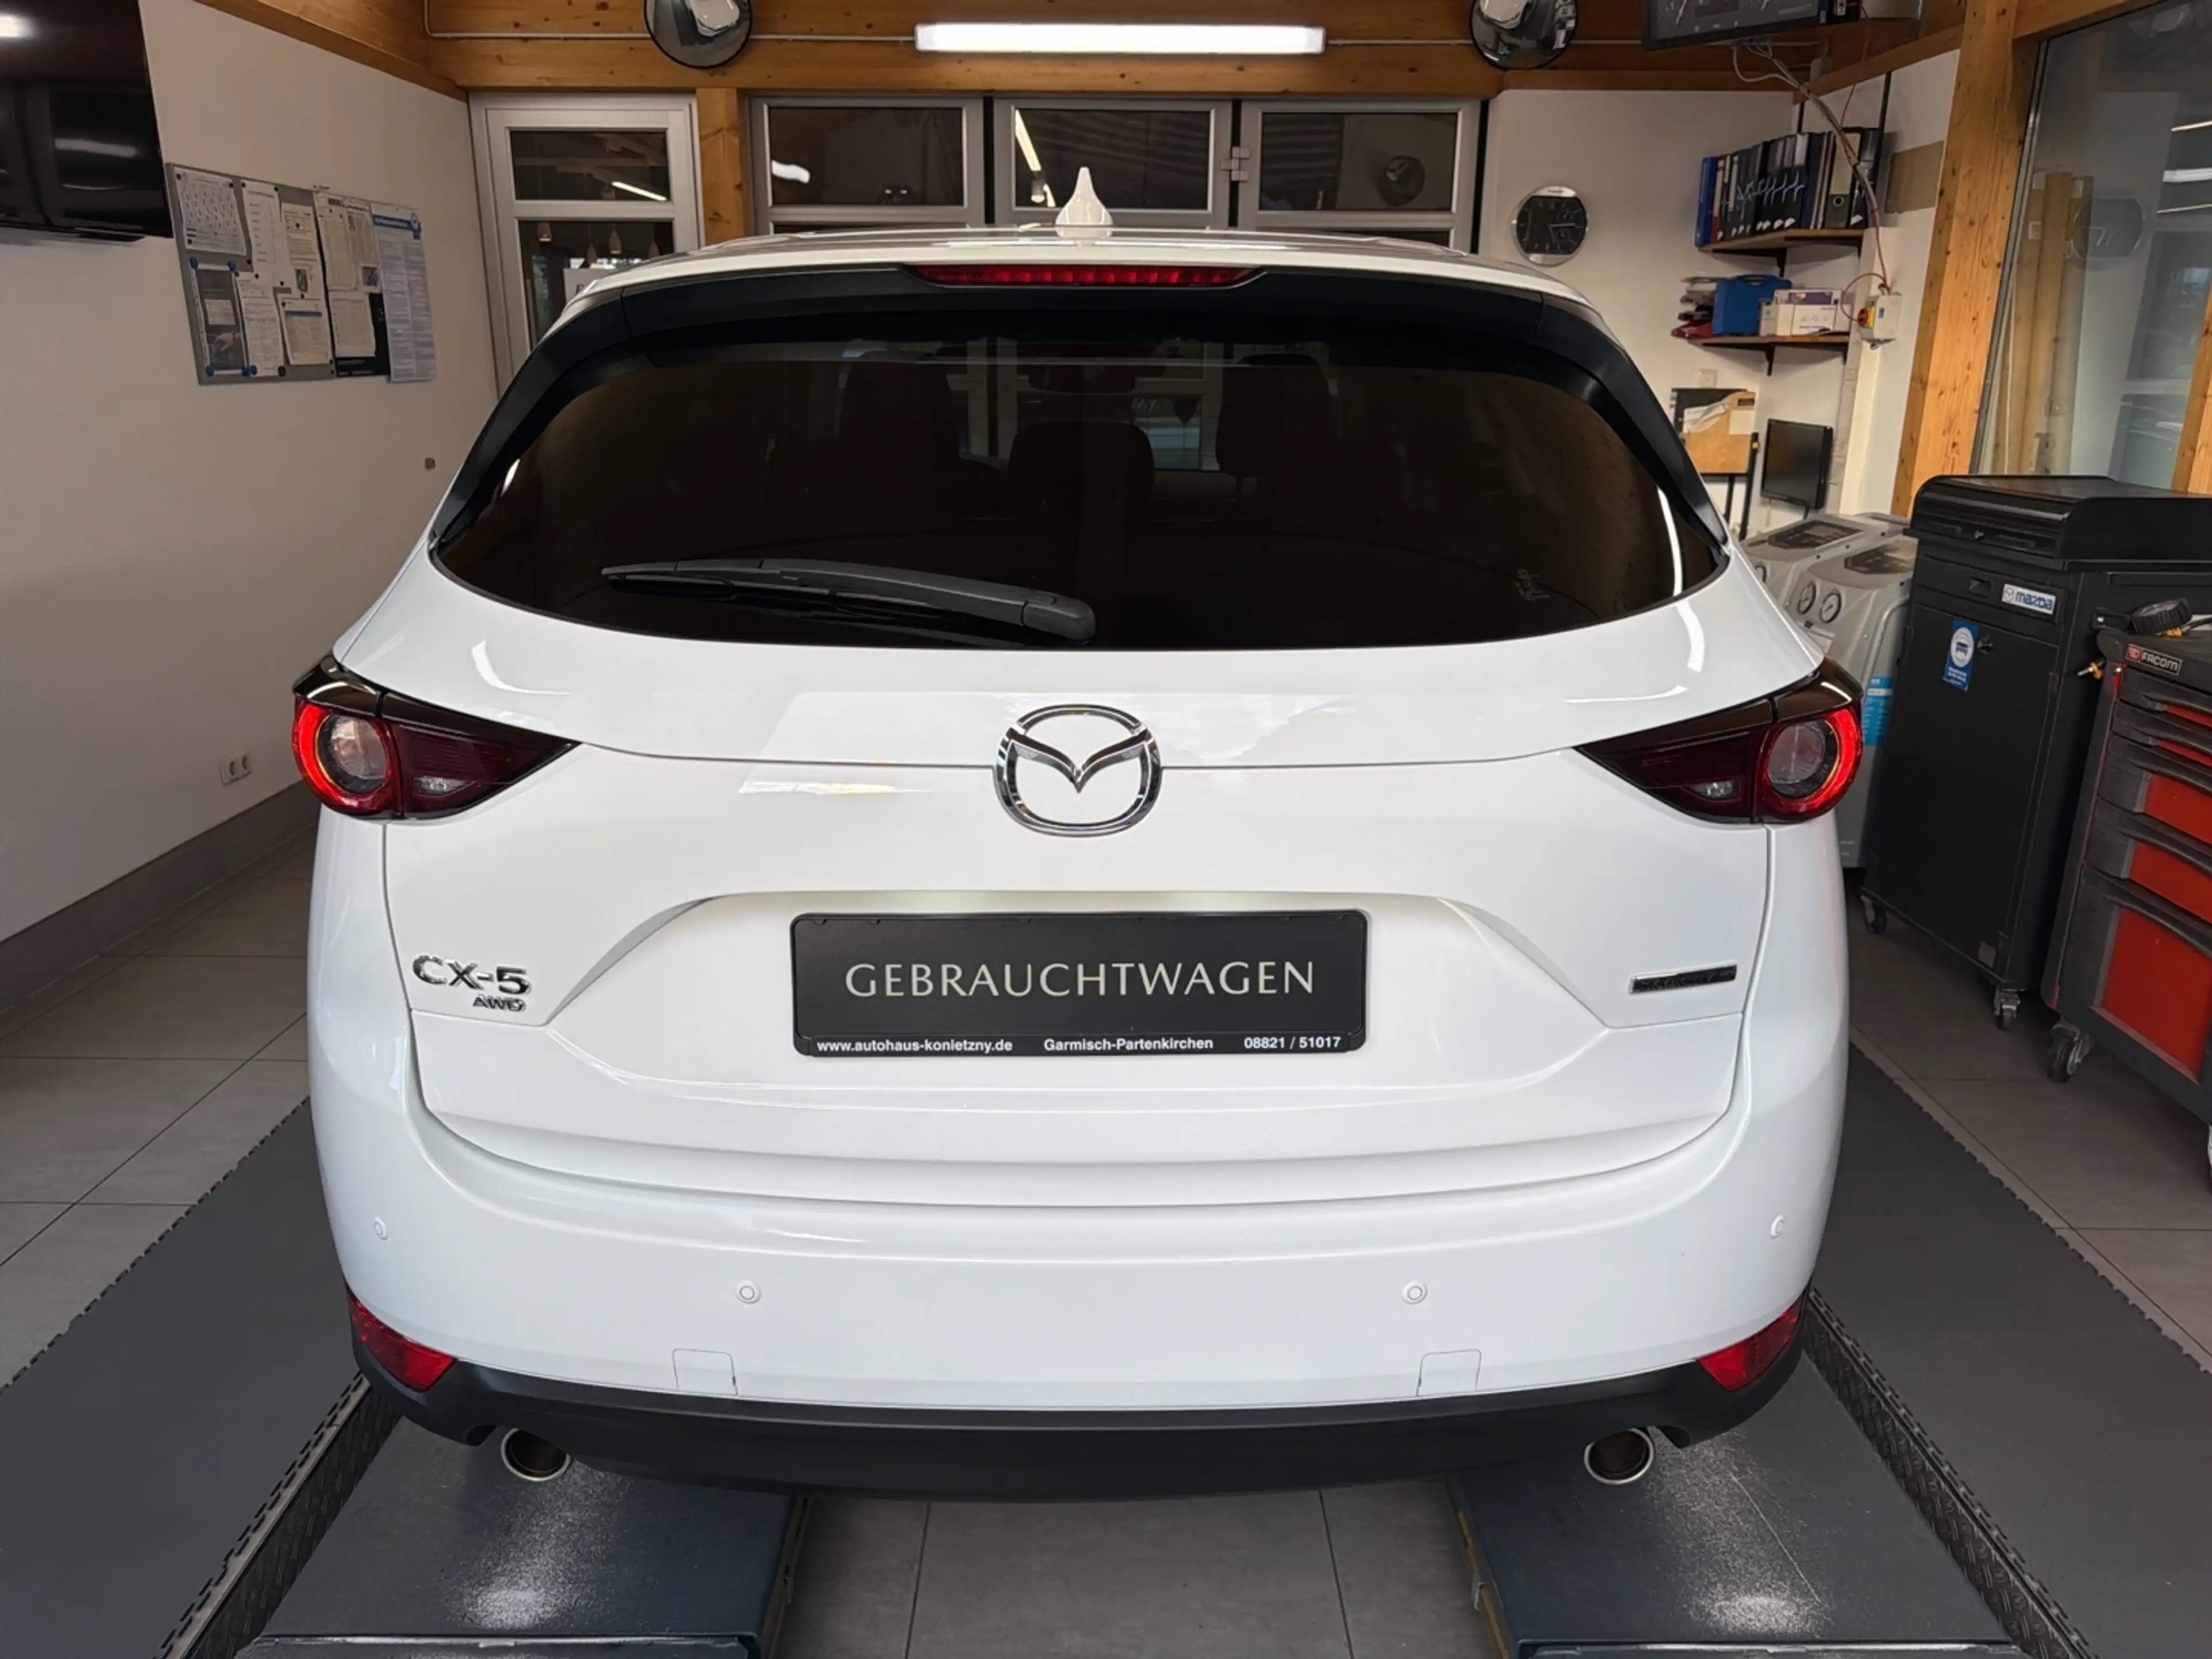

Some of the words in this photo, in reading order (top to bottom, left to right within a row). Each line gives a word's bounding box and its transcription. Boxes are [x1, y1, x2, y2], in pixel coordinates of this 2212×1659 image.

[412, 954, 532, 994] CX-5
[845, 961, 1313, 997] GEBRAUCHTWAGEN
[472, 994, 527, 1012] AWD
[816, 1038, 1013, 1054] www.autohaus-konietzny.de
[1043, 1037, 1213, 1052] Garmisch-Partenkirchen
[1244, 1037, 1285, 1050] 08821
[1299, 1036, 1341, 1049] 51017
